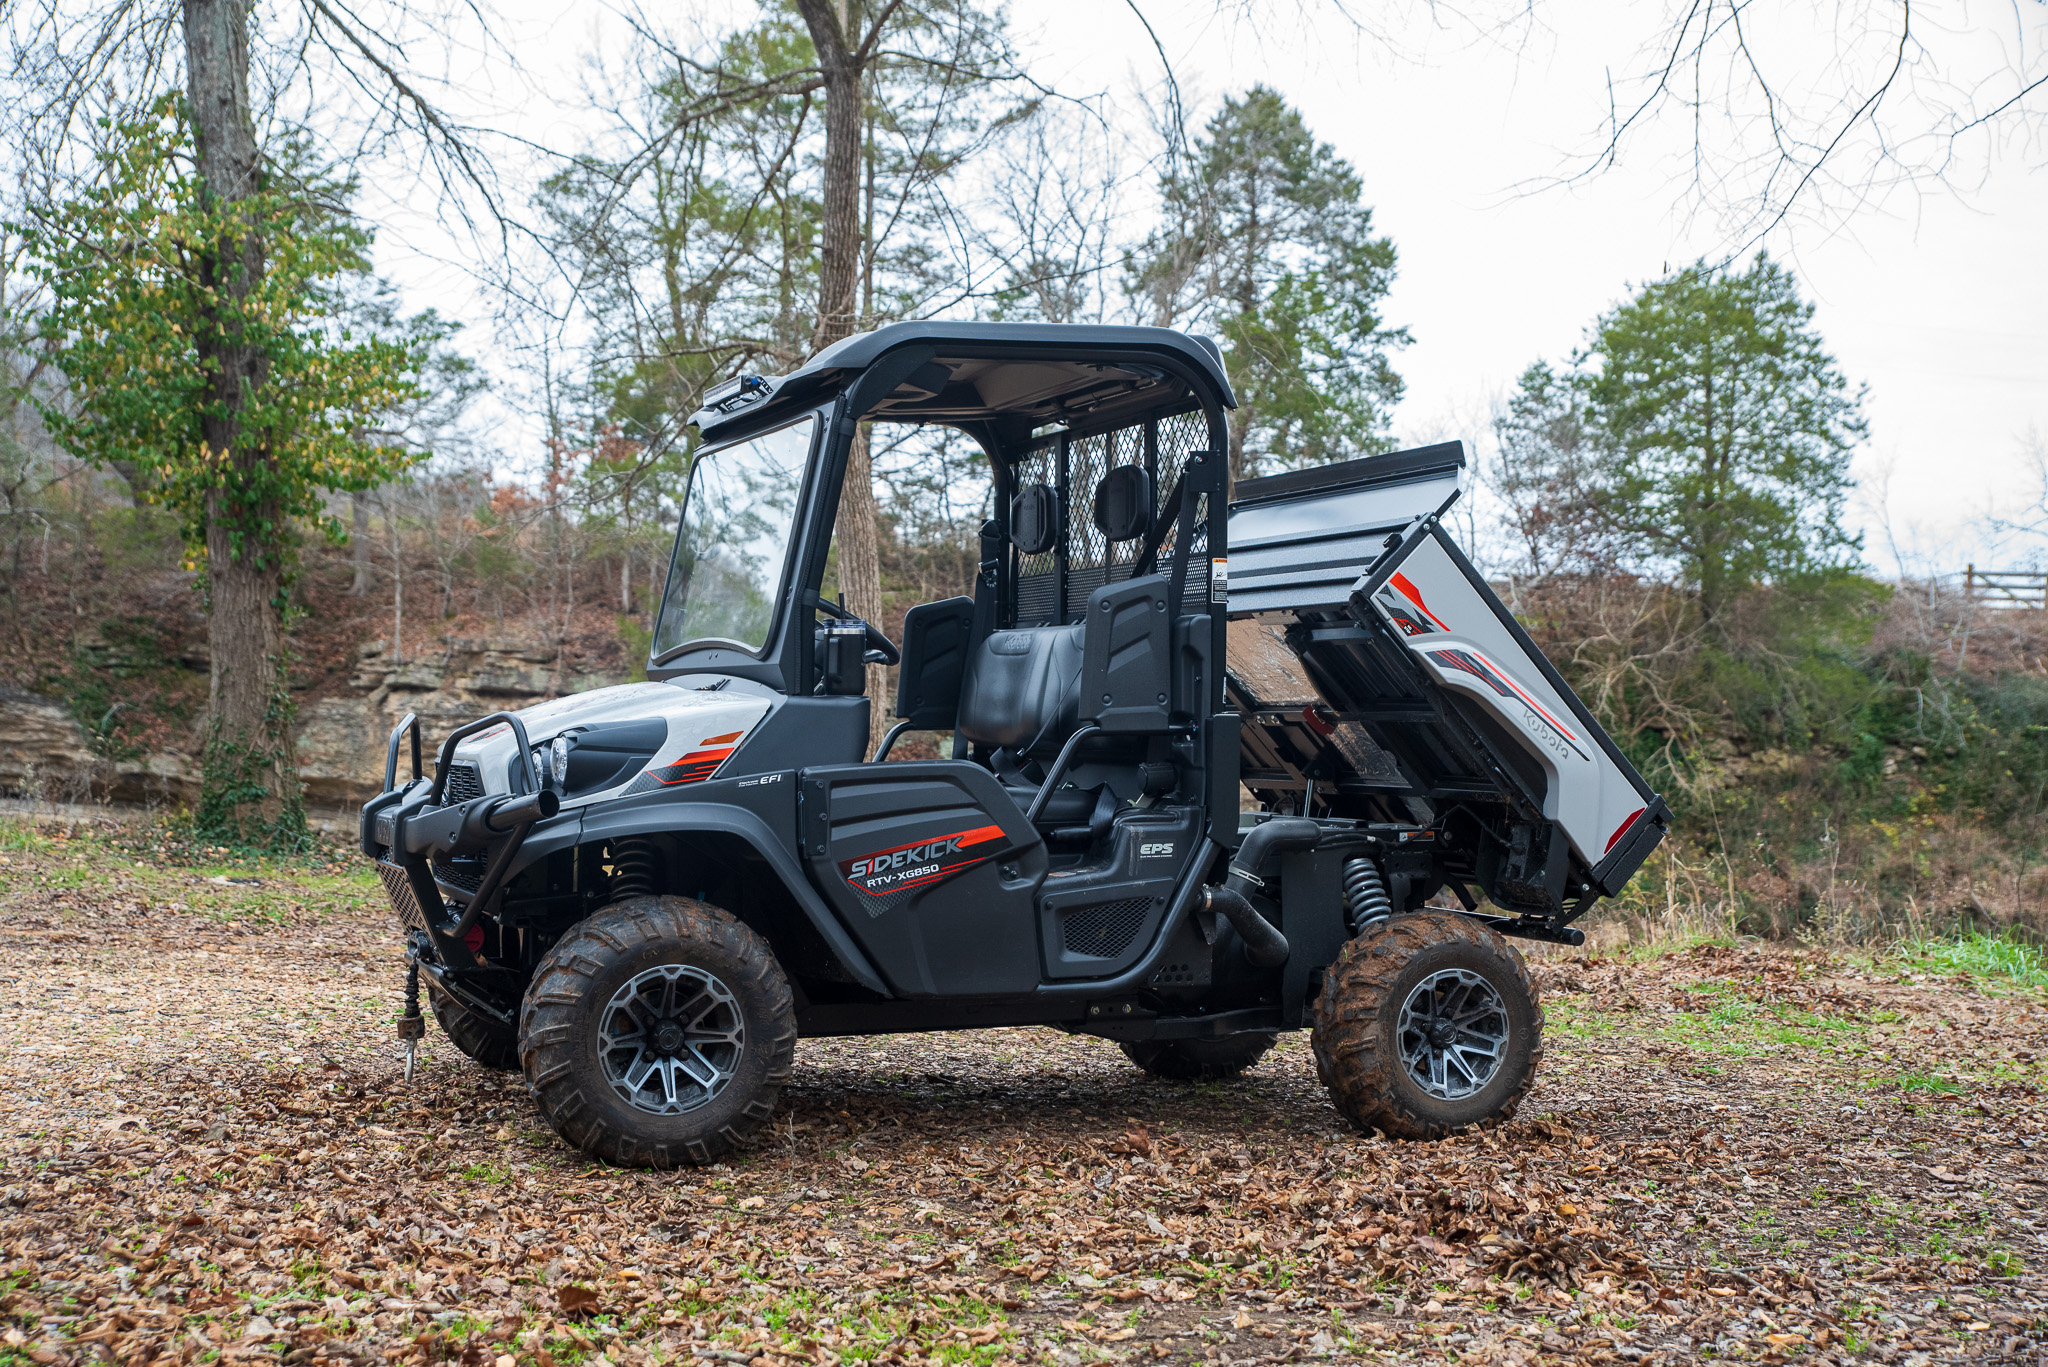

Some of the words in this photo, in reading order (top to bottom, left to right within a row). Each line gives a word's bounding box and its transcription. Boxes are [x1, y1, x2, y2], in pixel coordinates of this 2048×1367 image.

[1523, 709, 1569, 760] Kubota
[760, 774, 782, 785] EFI
[847, 835, 964, 880] SIDEKICK
[1140, 843, 1174, 855] EPS
[866, 863, 940, 888] RTV-XG850
